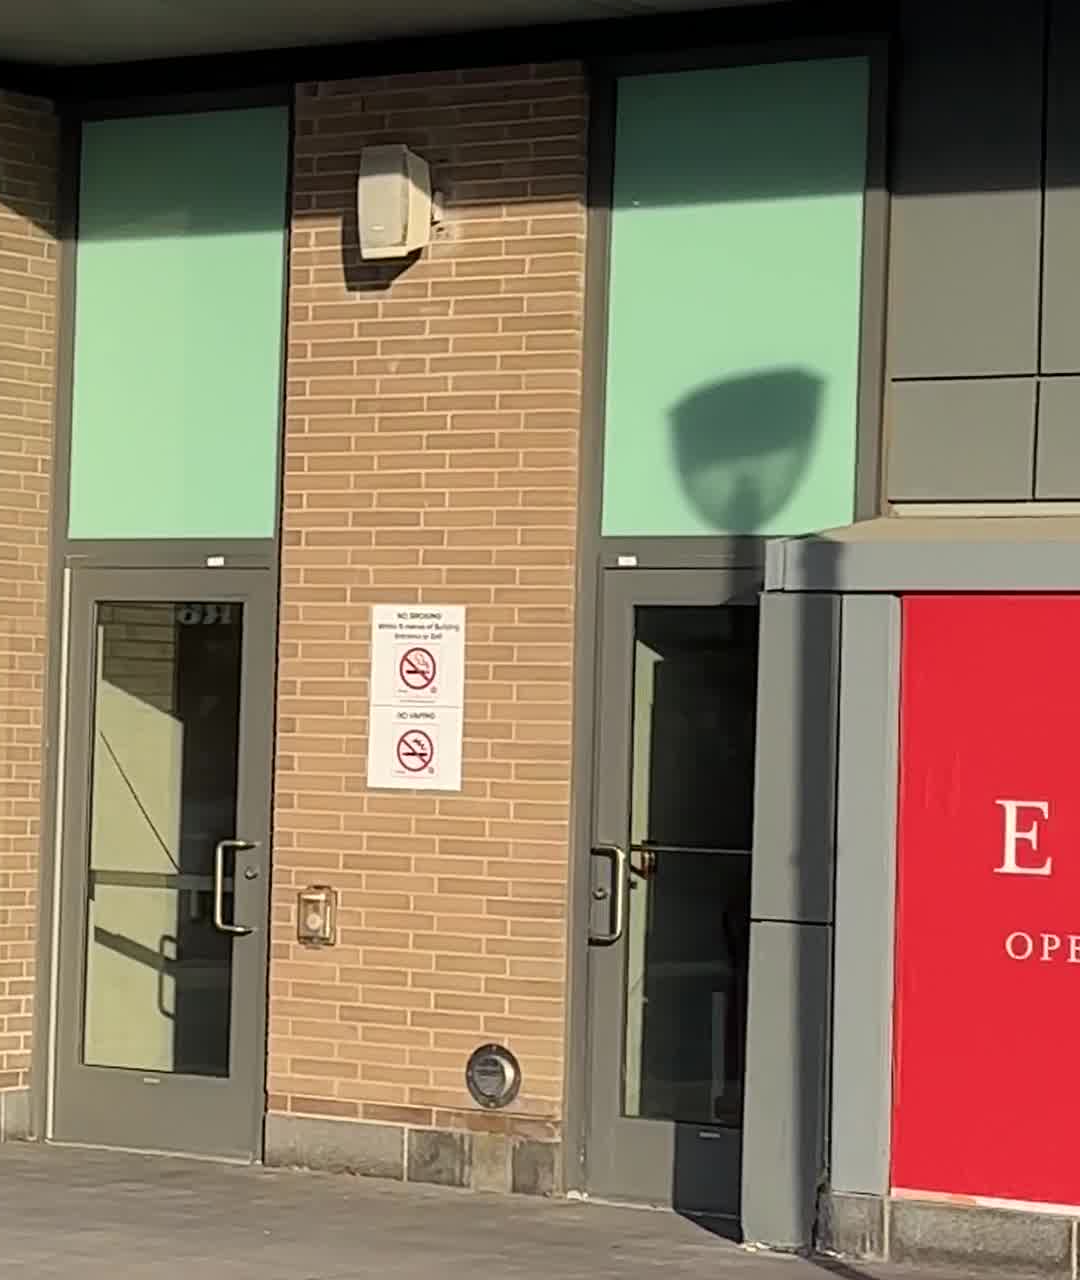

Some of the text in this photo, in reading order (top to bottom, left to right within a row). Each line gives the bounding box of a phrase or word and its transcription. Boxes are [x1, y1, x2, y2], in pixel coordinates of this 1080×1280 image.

[397, 612, 408, 620] NO
[396, 712, 408, 720] NO
[993, 799, 1052, 875] E
